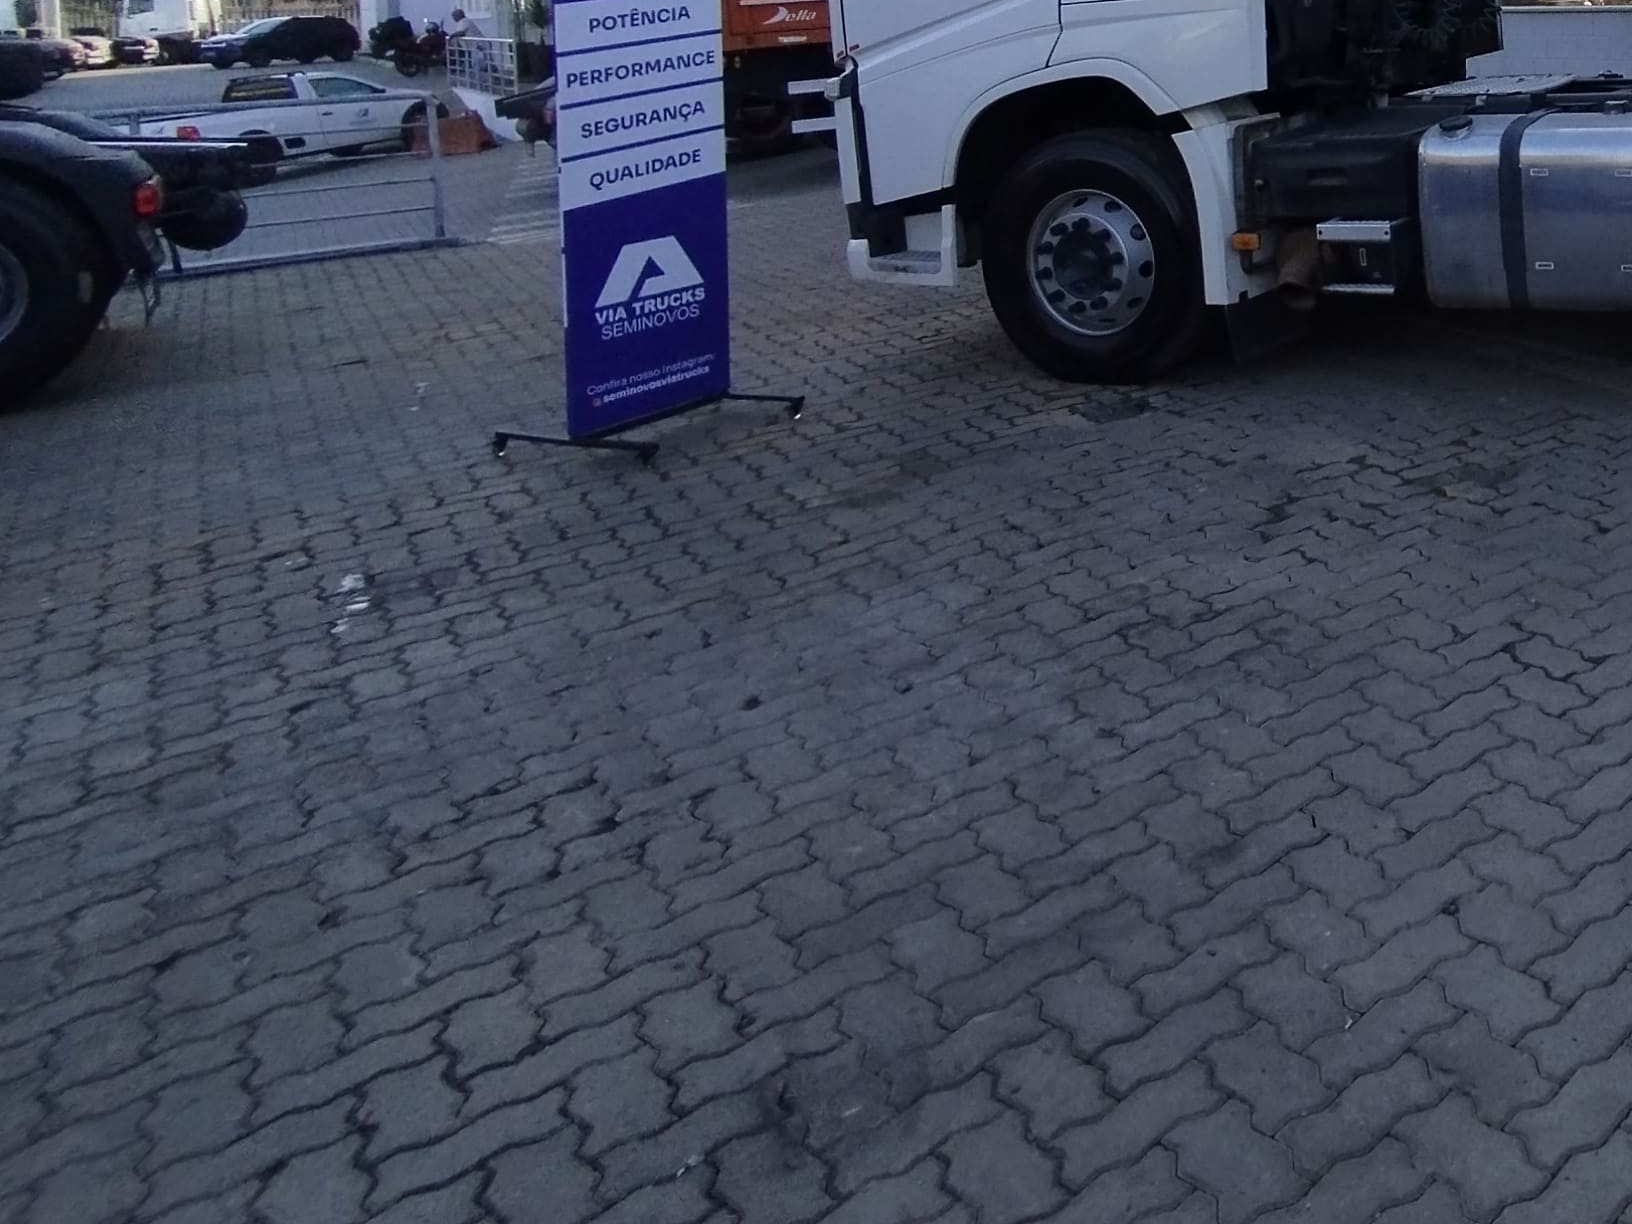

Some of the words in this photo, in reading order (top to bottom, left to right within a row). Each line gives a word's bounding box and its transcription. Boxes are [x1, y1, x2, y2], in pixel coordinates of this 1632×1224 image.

[588, 6, 691, 33] POTÊNCIA
[566, 50, 715, 88] PERFORMANCE
[580, 100, 705, 139] SEGURANÇA
[589, 148, 702, 191] QUALIDADE
[595, 306, 627, 325] VIA
[631, 287, 706, 316] TRUCKS
[601, 303, 700, 340] SEMINOVOS
[586, 377, 628, 395] Confira
[629, 368, 661, 383] nosso
